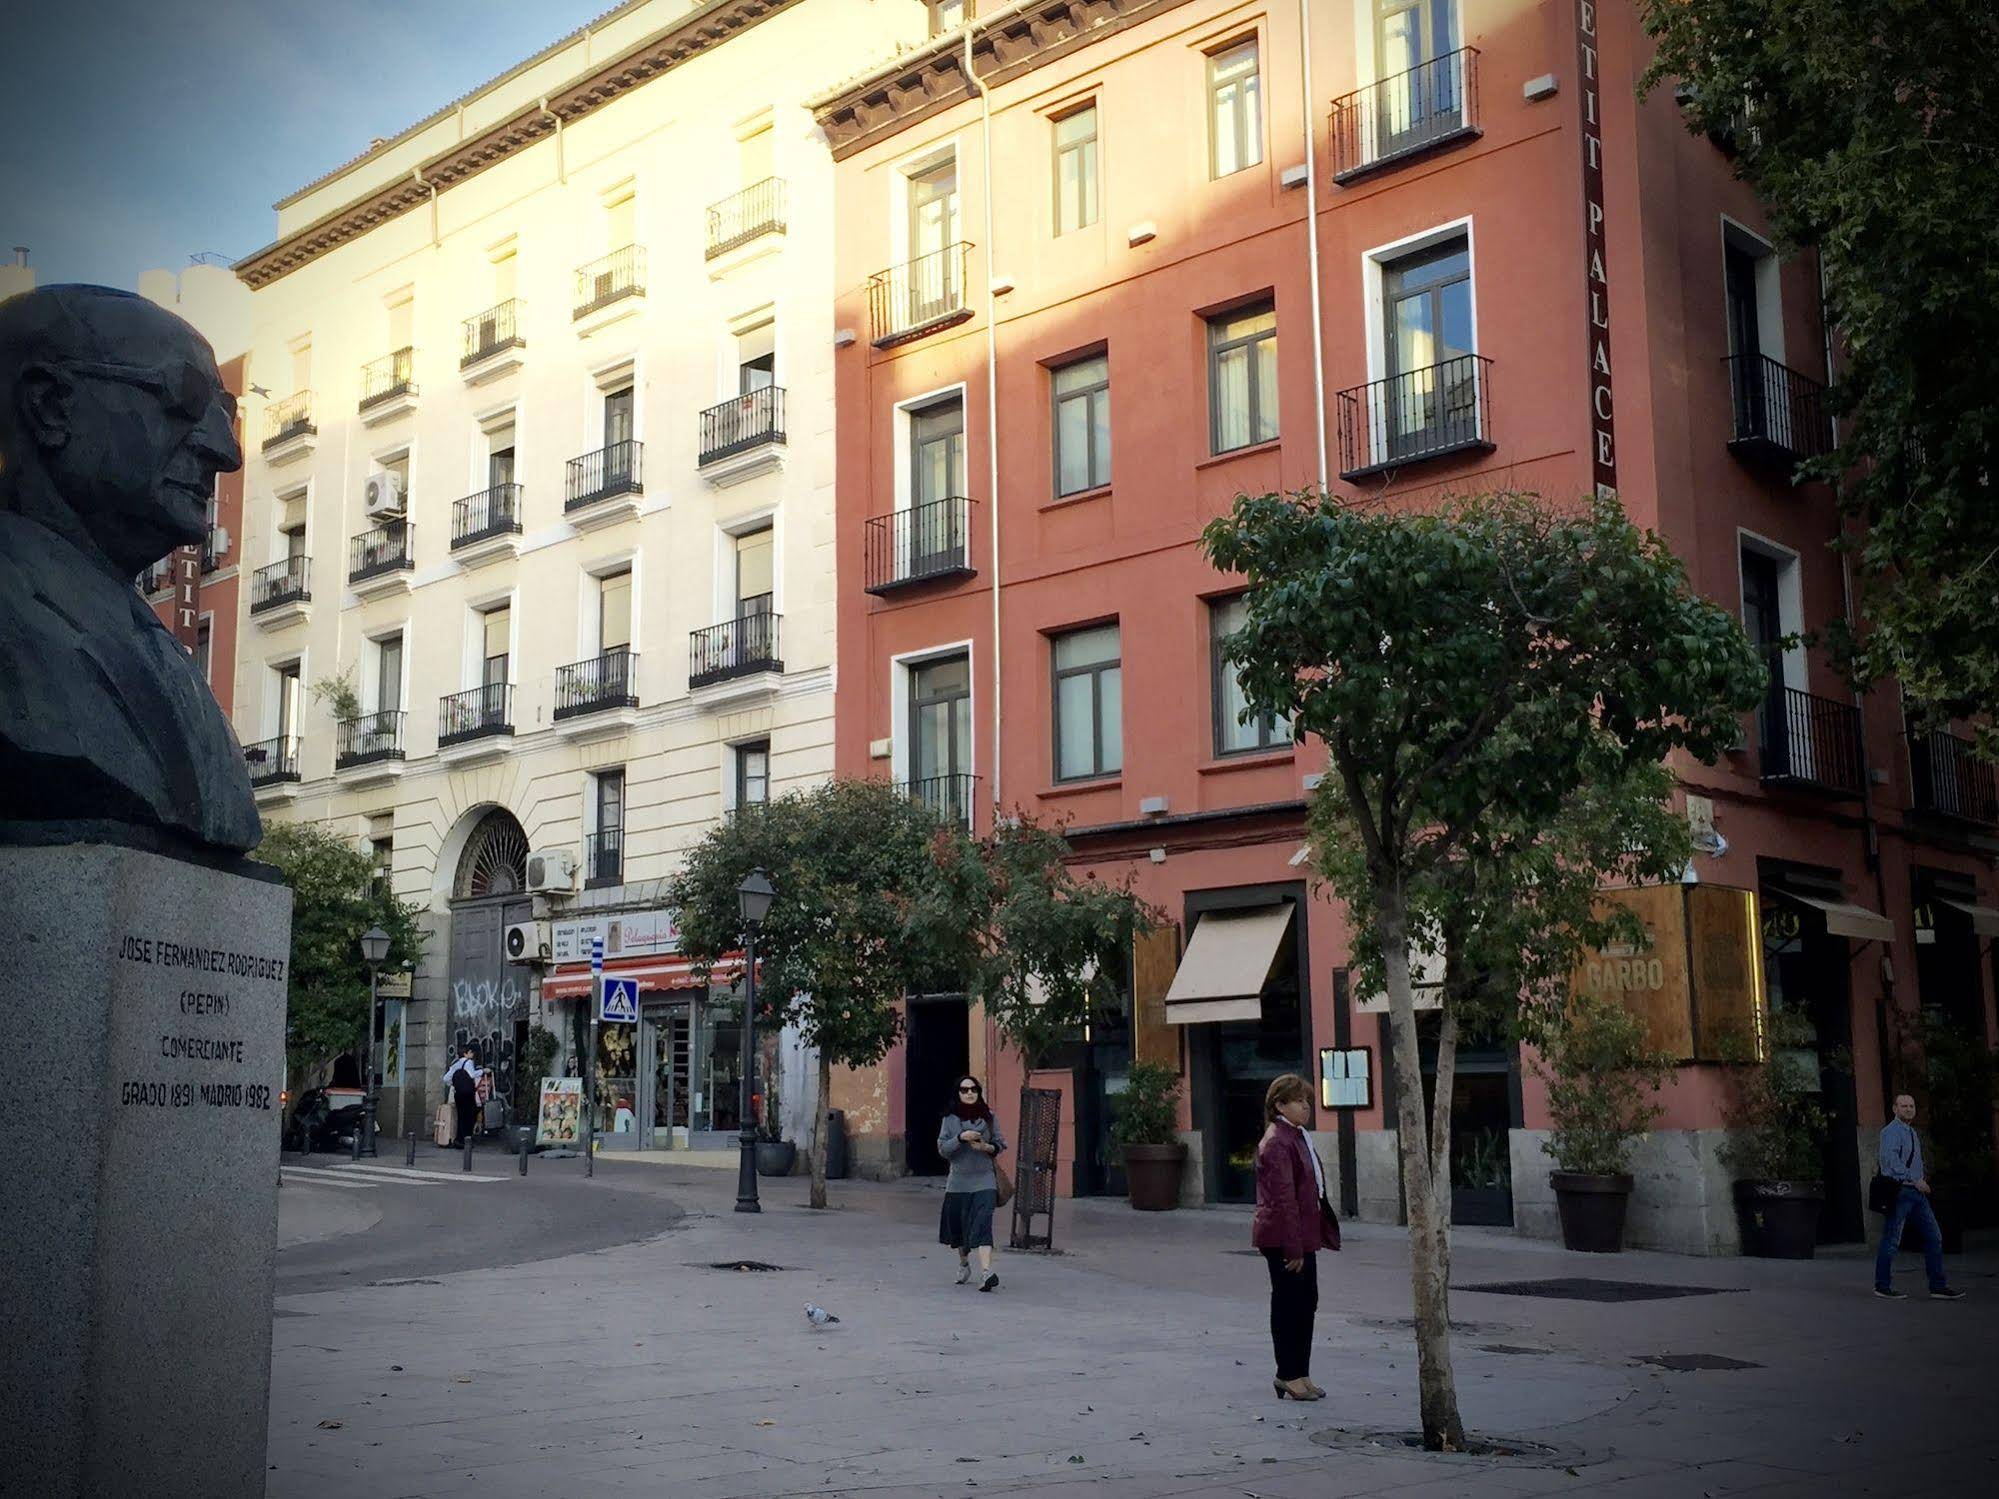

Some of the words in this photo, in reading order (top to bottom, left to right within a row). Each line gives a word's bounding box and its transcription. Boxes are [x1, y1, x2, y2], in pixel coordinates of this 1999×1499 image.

[1588, 199, 1614, 468] PALACE
[118, 936, 152, 963] JOSE
[156, 941, 226, 973] FERNANDEZ
[227, 952, 285, 982] RODRIGUEZ
[161, 1036, 243, 1063] COMERCIANTE
[121, 1082, 167, 1108] GRADO
[170, 1083, 195, 1107] 1891
[200, 1083, 243, 1107] MADRID
[244, 1084, 271, 1110] 1982
